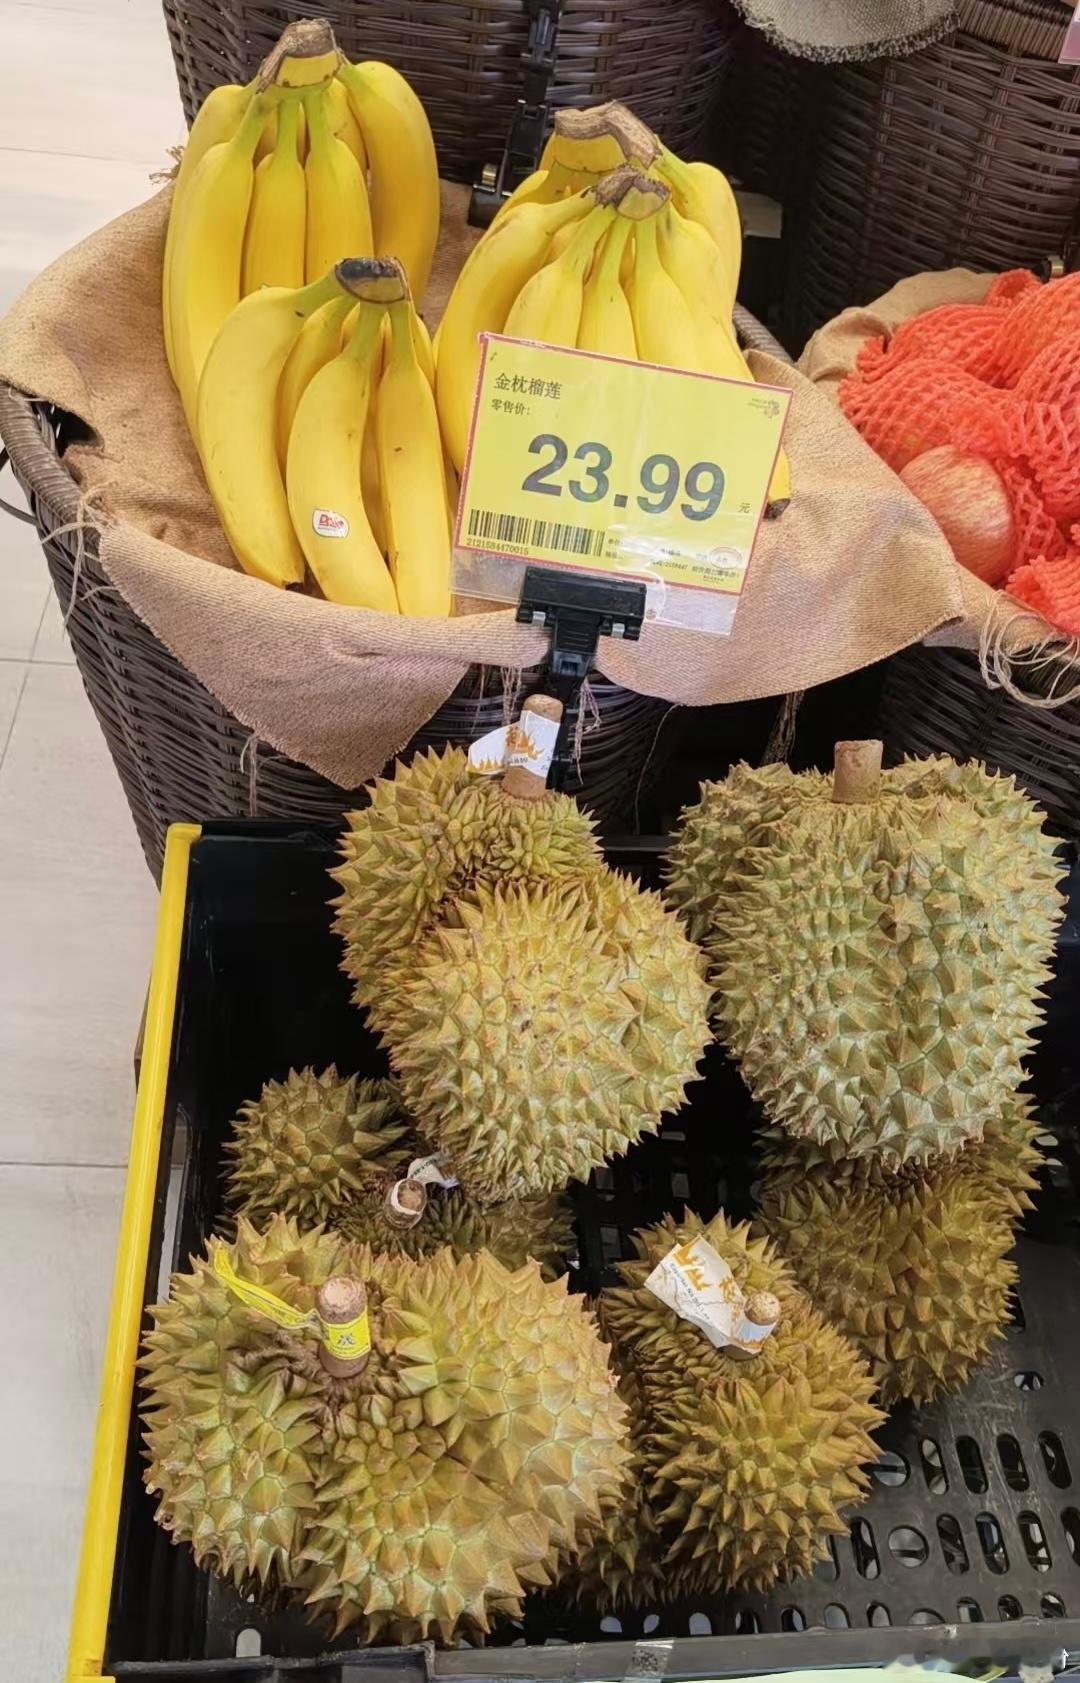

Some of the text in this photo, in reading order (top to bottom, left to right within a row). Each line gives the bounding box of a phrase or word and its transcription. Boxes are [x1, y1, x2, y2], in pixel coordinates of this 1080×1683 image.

[493, 372, 562, 400] 金枕榴莲
[521, 433, 725, 521] 23.99
[739, 502, 751, 514] 元
